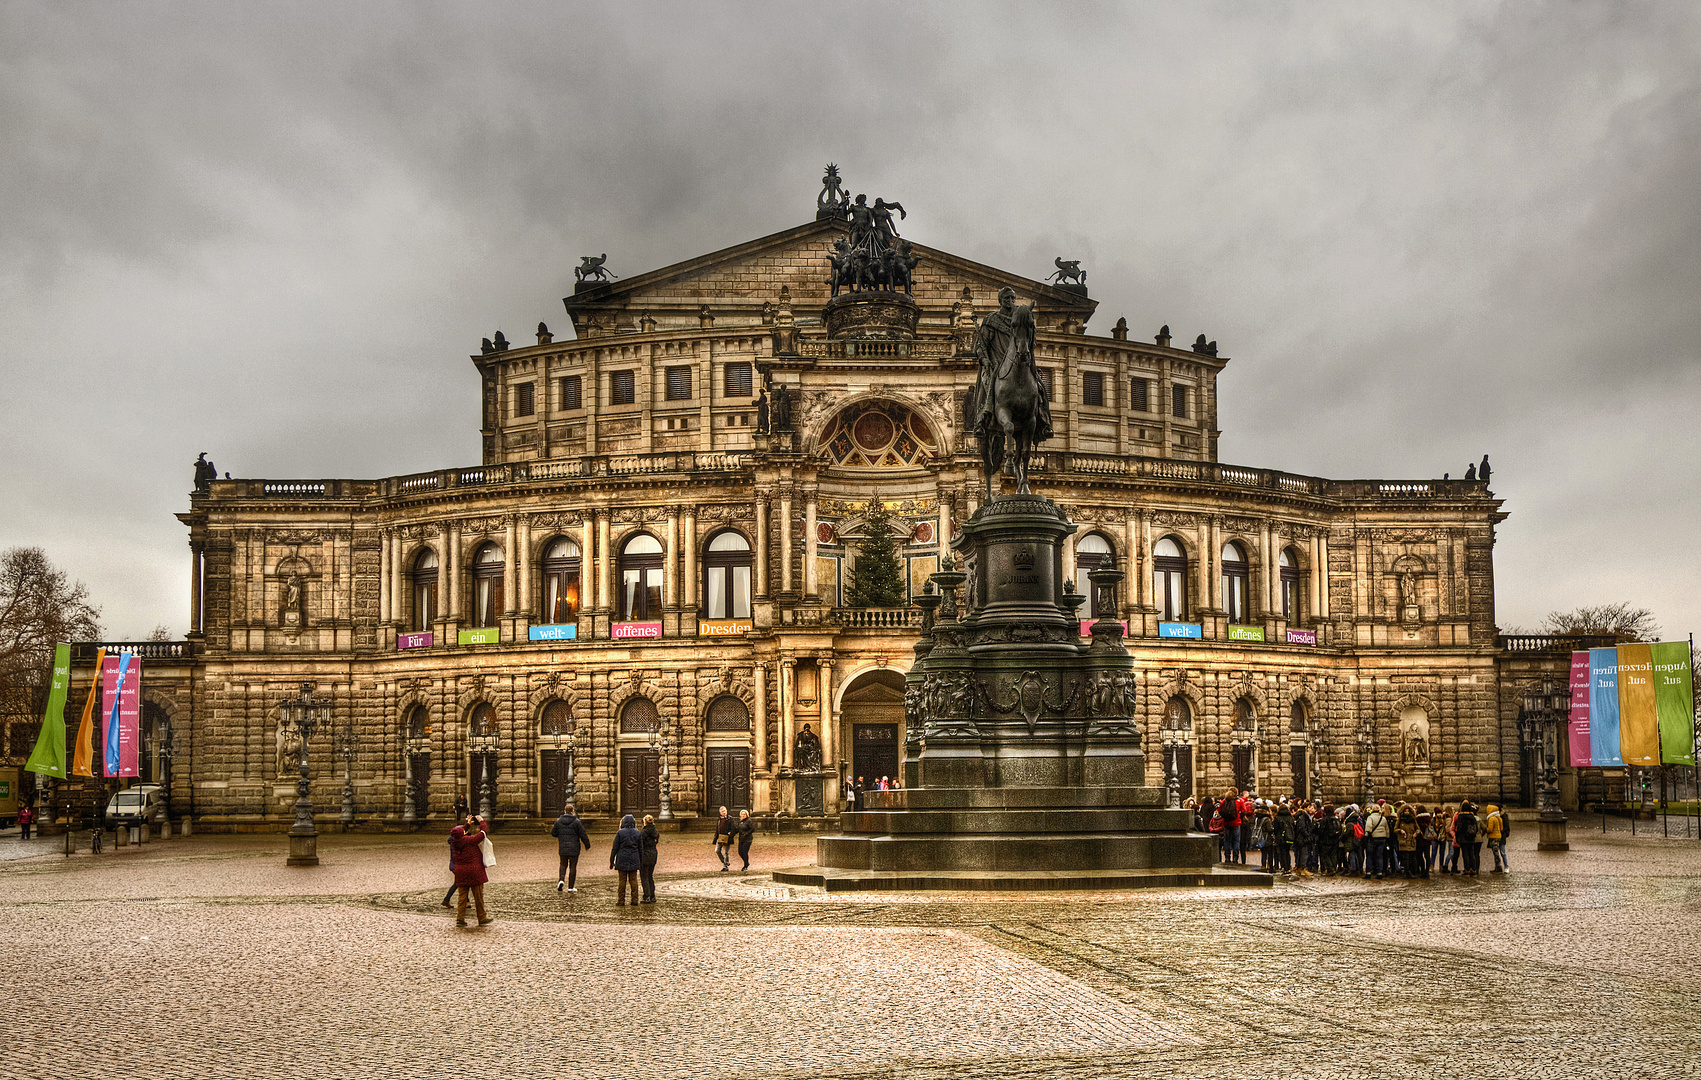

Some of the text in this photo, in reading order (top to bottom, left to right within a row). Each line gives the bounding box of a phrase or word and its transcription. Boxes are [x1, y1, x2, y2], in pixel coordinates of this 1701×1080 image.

[539, 628, 566, 639] welt-
[615, 625, 658, 638] offenes
[700, 623, 751, 635] Dresden
[1168, 626, 1193, 637] welt-
[1231, 629, 1262, 641] offenes
[408, 635, 423, 647] Für
[471, 632, 486, 643] ein
[1287, 631, 1316, 645] Dresden
